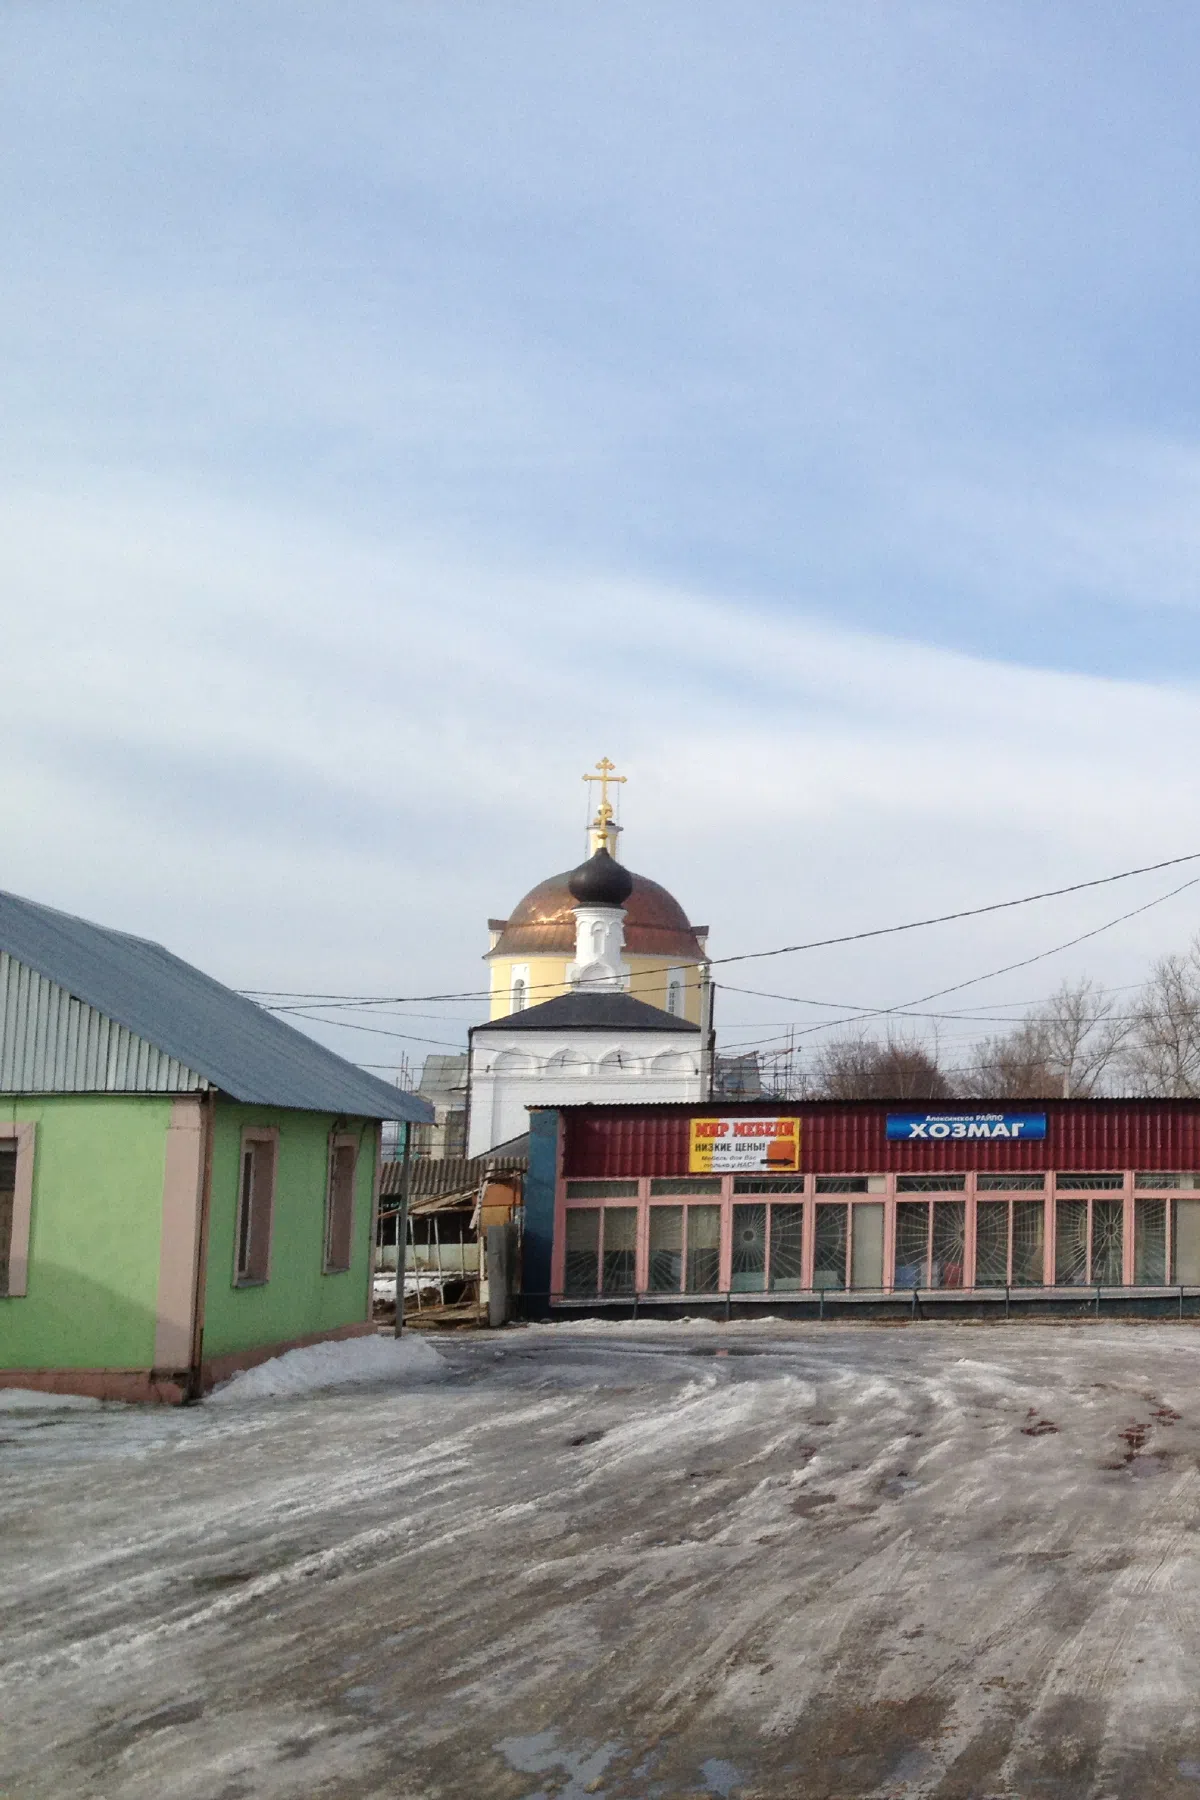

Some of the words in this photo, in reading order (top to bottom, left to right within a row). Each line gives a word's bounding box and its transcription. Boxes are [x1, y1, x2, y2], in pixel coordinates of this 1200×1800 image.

[975, 1113, 1004, 1121] РАЙПО
[695, 1123, 729, 1137] МИР
[732, 1121, 794, 1137] МЕБЕЛИ
[908, 1123, 1025, 1138] ХОЗМАГ
[695, 1142, 732, 1152] НИЗКИЕ
[735, 1142, 765, 1152] ЦЕНЫ!
